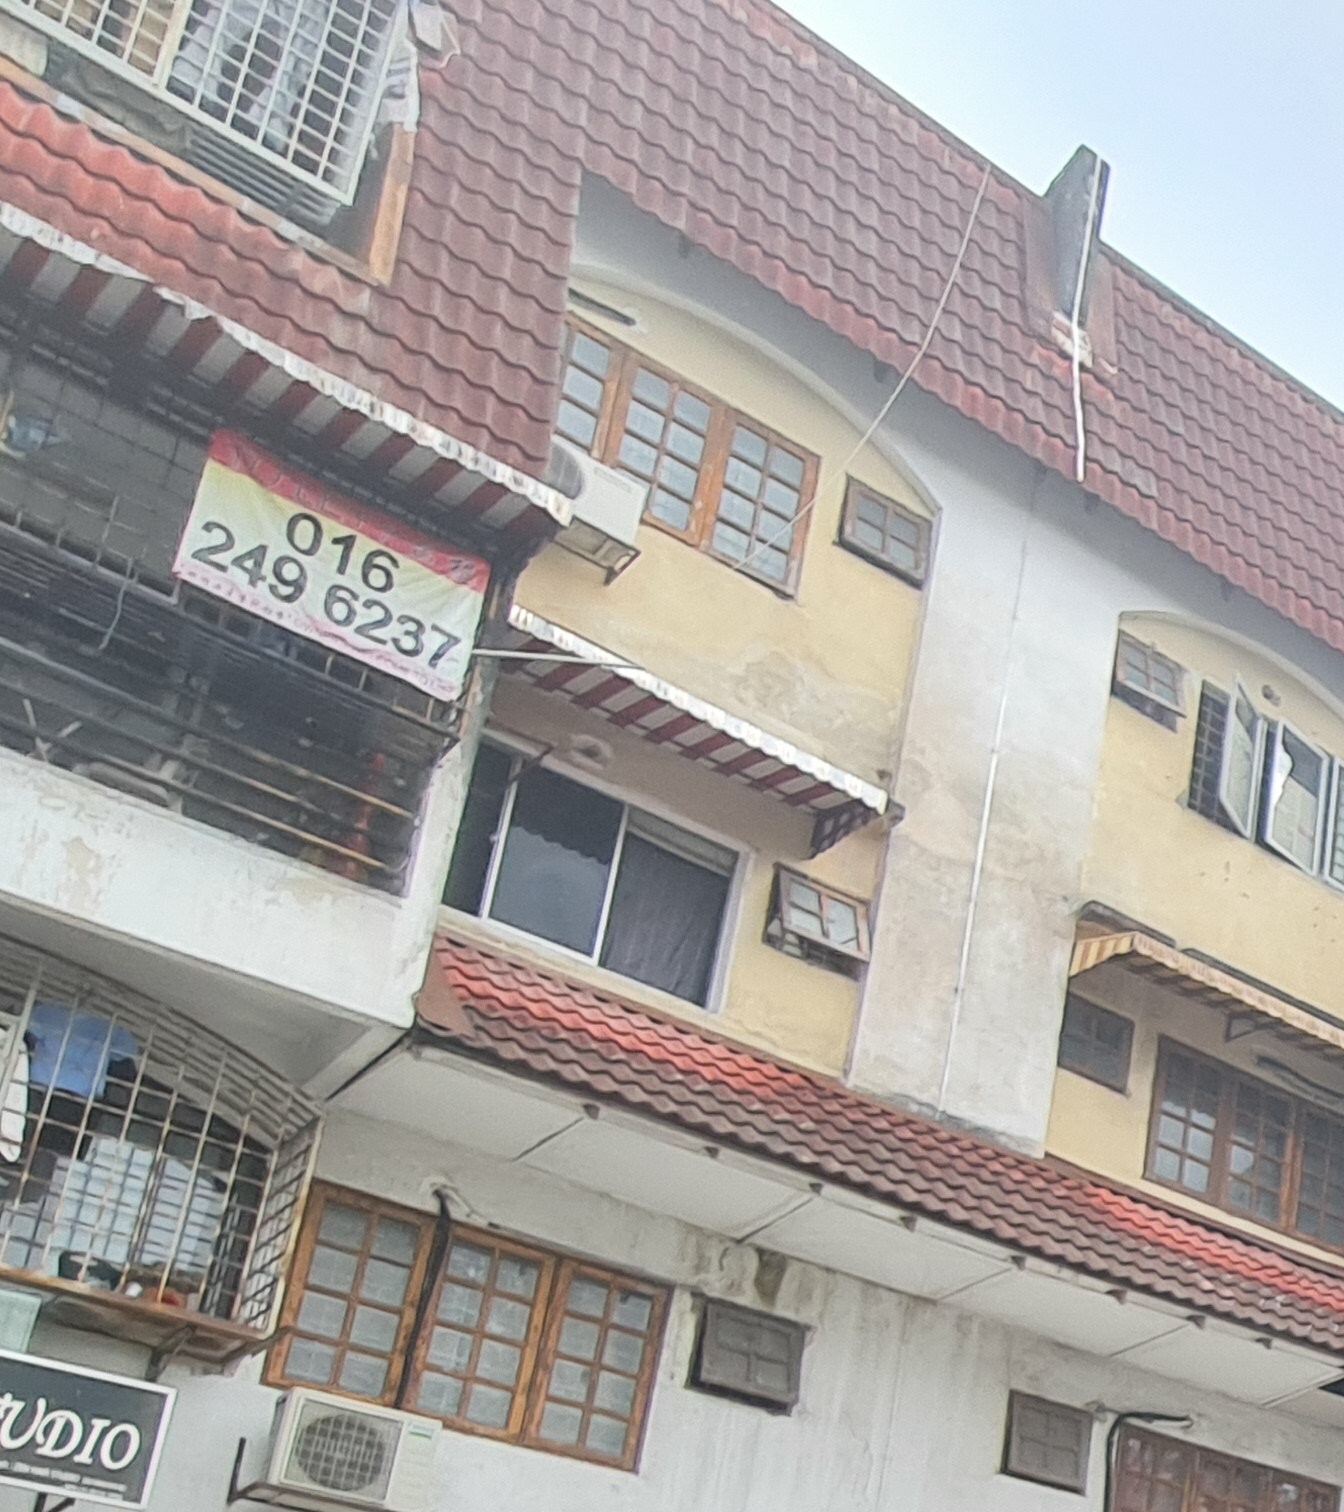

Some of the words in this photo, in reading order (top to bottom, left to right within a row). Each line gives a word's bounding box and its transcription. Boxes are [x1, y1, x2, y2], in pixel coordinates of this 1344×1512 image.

[191, 521, 308, 604] 249
[324, 584, 463, 670] 6237
[286, 512, 399, 593] 016
